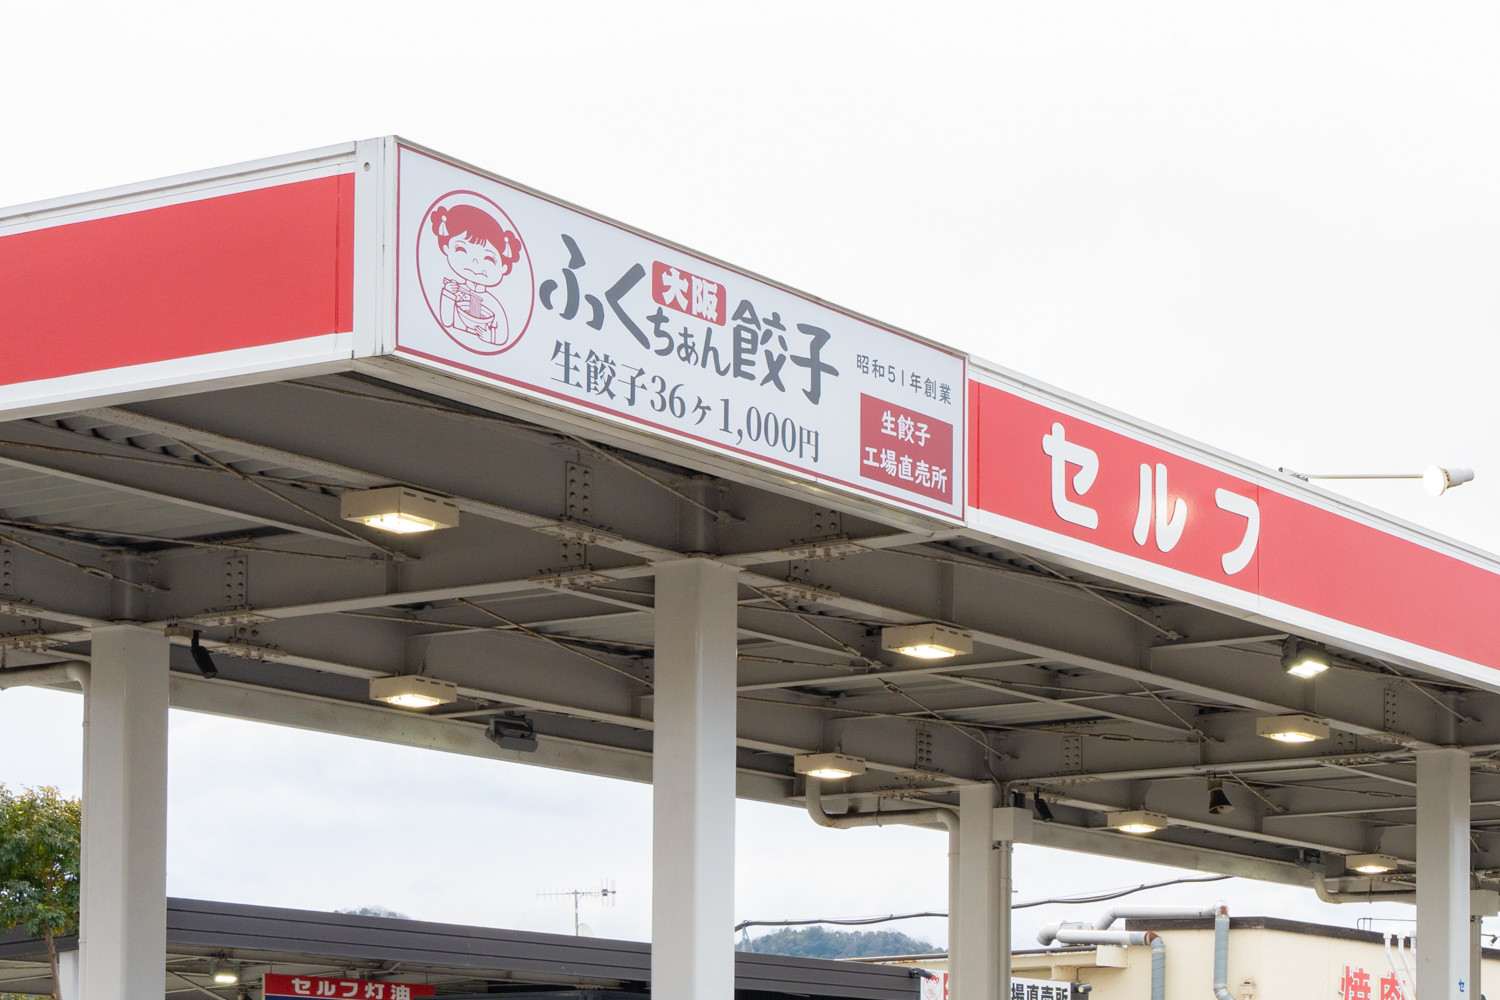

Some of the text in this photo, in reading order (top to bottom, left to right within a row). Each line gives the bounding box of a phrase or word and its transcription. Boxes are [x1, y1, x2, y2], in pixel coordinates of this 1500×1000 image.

[661, 267, 720, 321] 大阪
[856, 352, 952, 405] 昭和51年創業
[880, 409, 931, 445] 生餃子
[863, 447, 948, 493] 工場直売所
[1042, 422, 1260, 575] セルフ
[292, 978, 410, 1000] セルフ灯油
